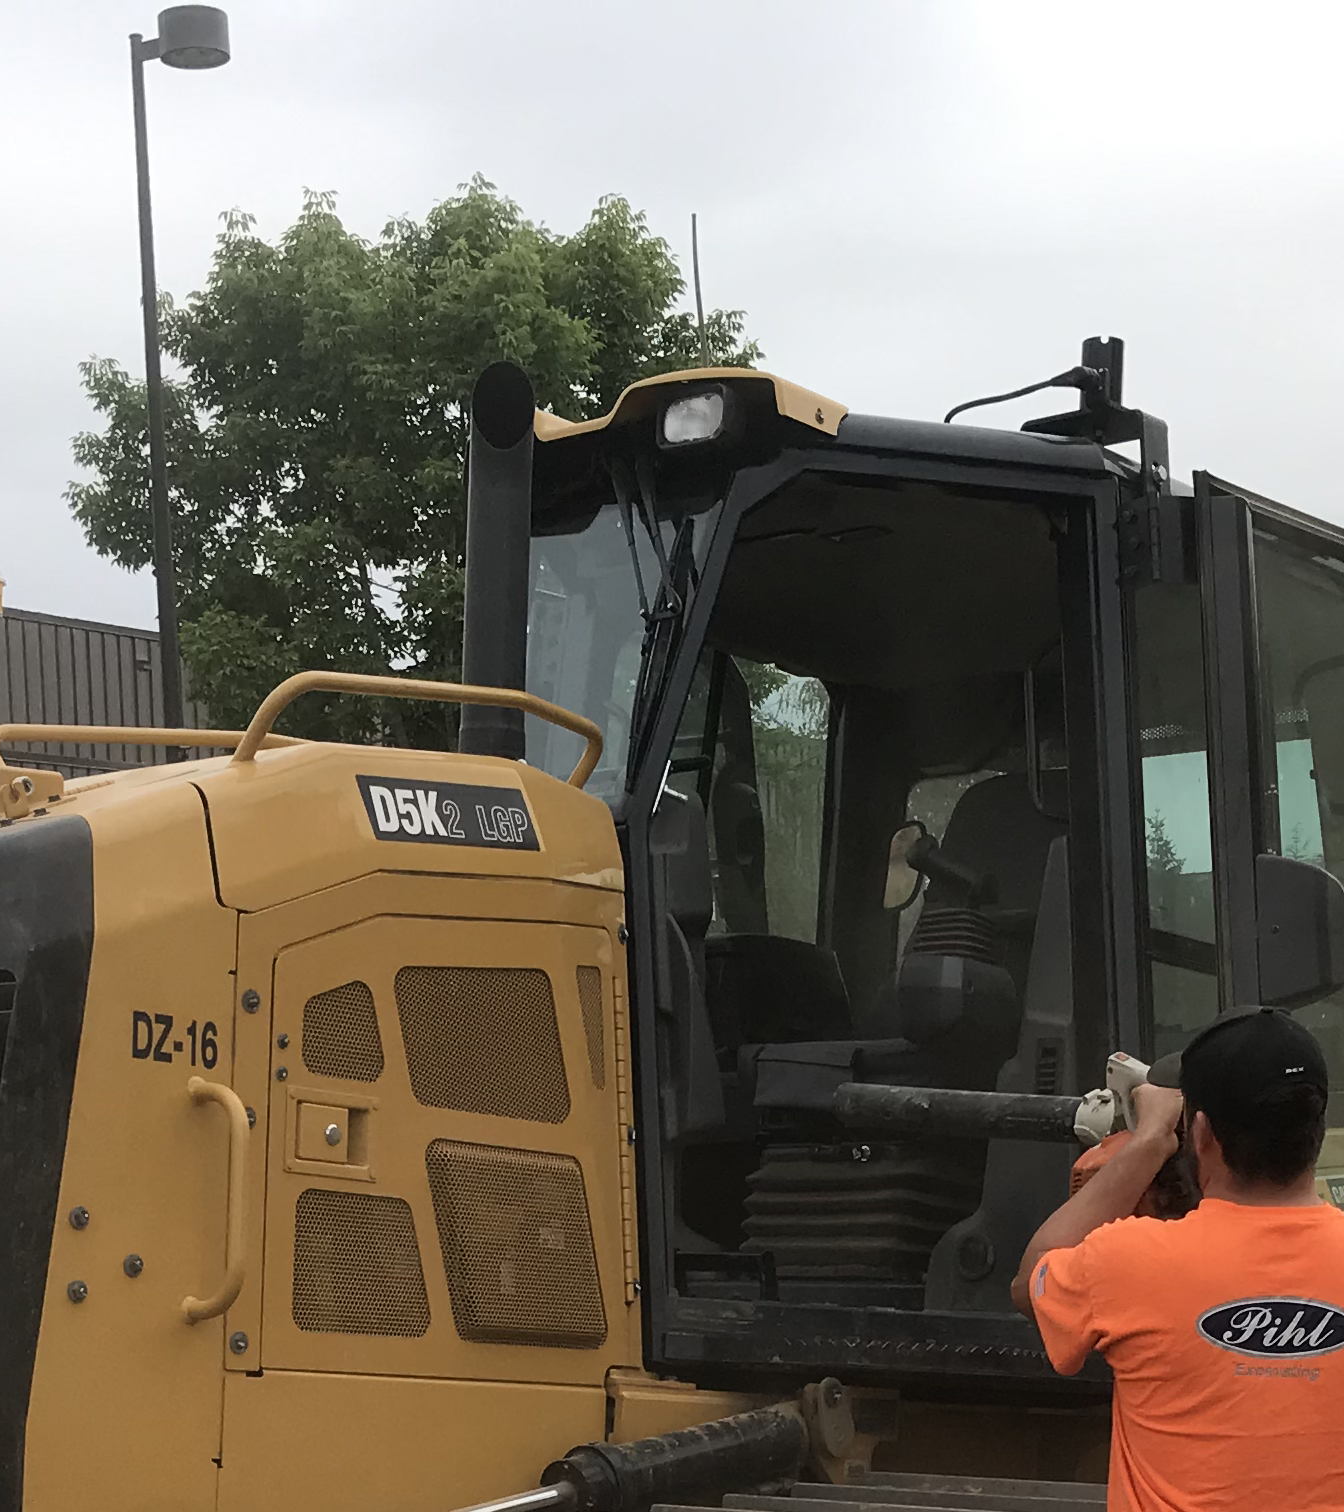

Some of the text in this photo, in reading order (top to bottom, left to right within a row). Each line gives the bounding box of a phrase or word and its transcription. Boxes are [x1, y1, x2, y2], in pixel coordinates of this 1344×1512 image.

[369, 784, 528, 843] D5K2 LGP
[132, 1010, 218, 1070] DZ-16
[1222, 1306, 1335, 1347] Pihl
